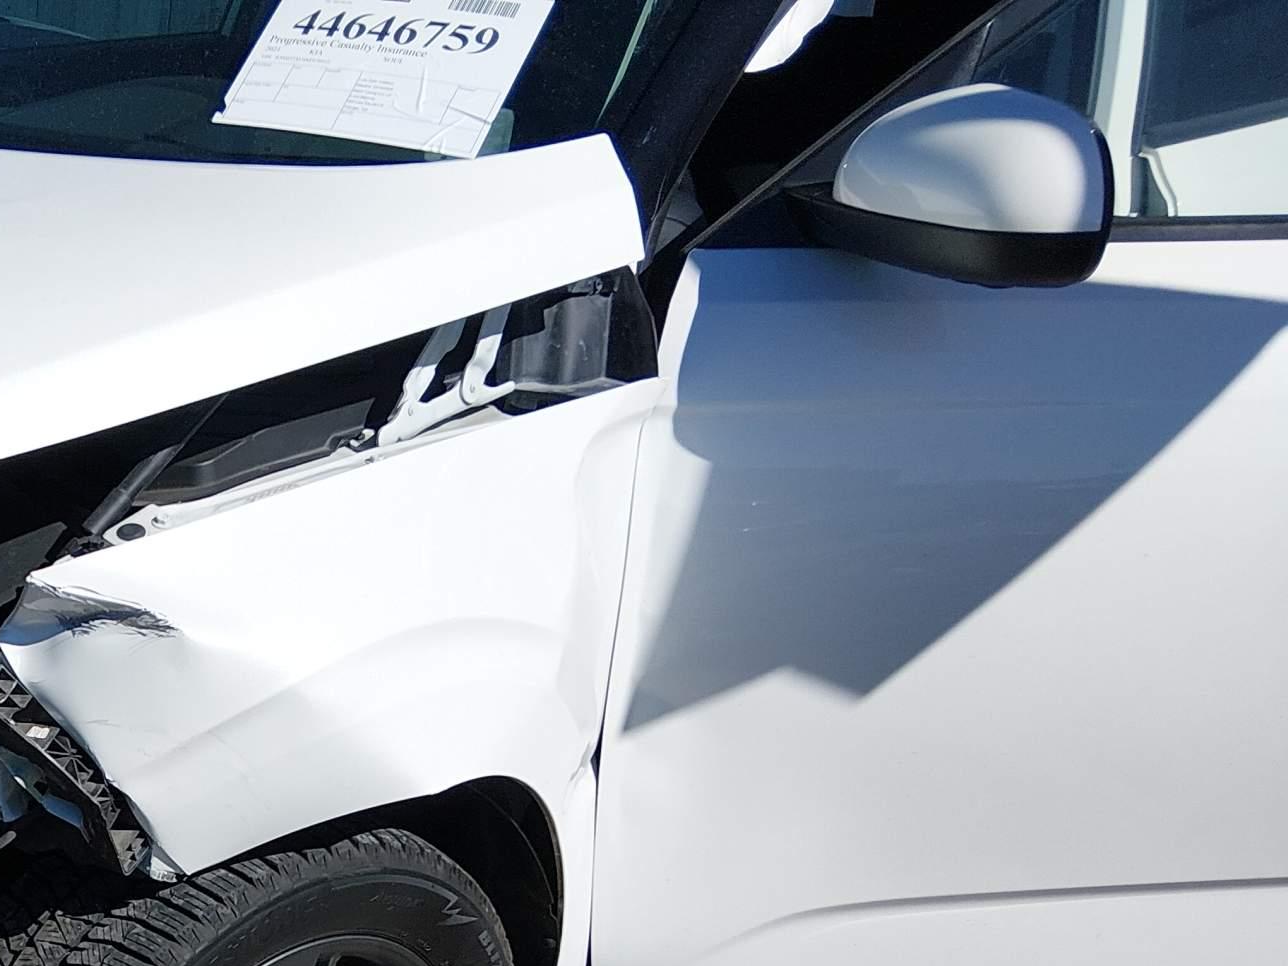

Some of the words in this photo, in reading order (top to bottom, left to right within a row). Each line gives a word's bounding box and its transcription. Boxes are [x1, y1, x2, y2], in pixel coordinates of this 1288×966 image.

[269, 35, 328, 48] Progressive
[329, 40, 375, 53] Casualty
[377, 44, 428, 58] Insurance
[293, 9, 500, 54] 44646759
